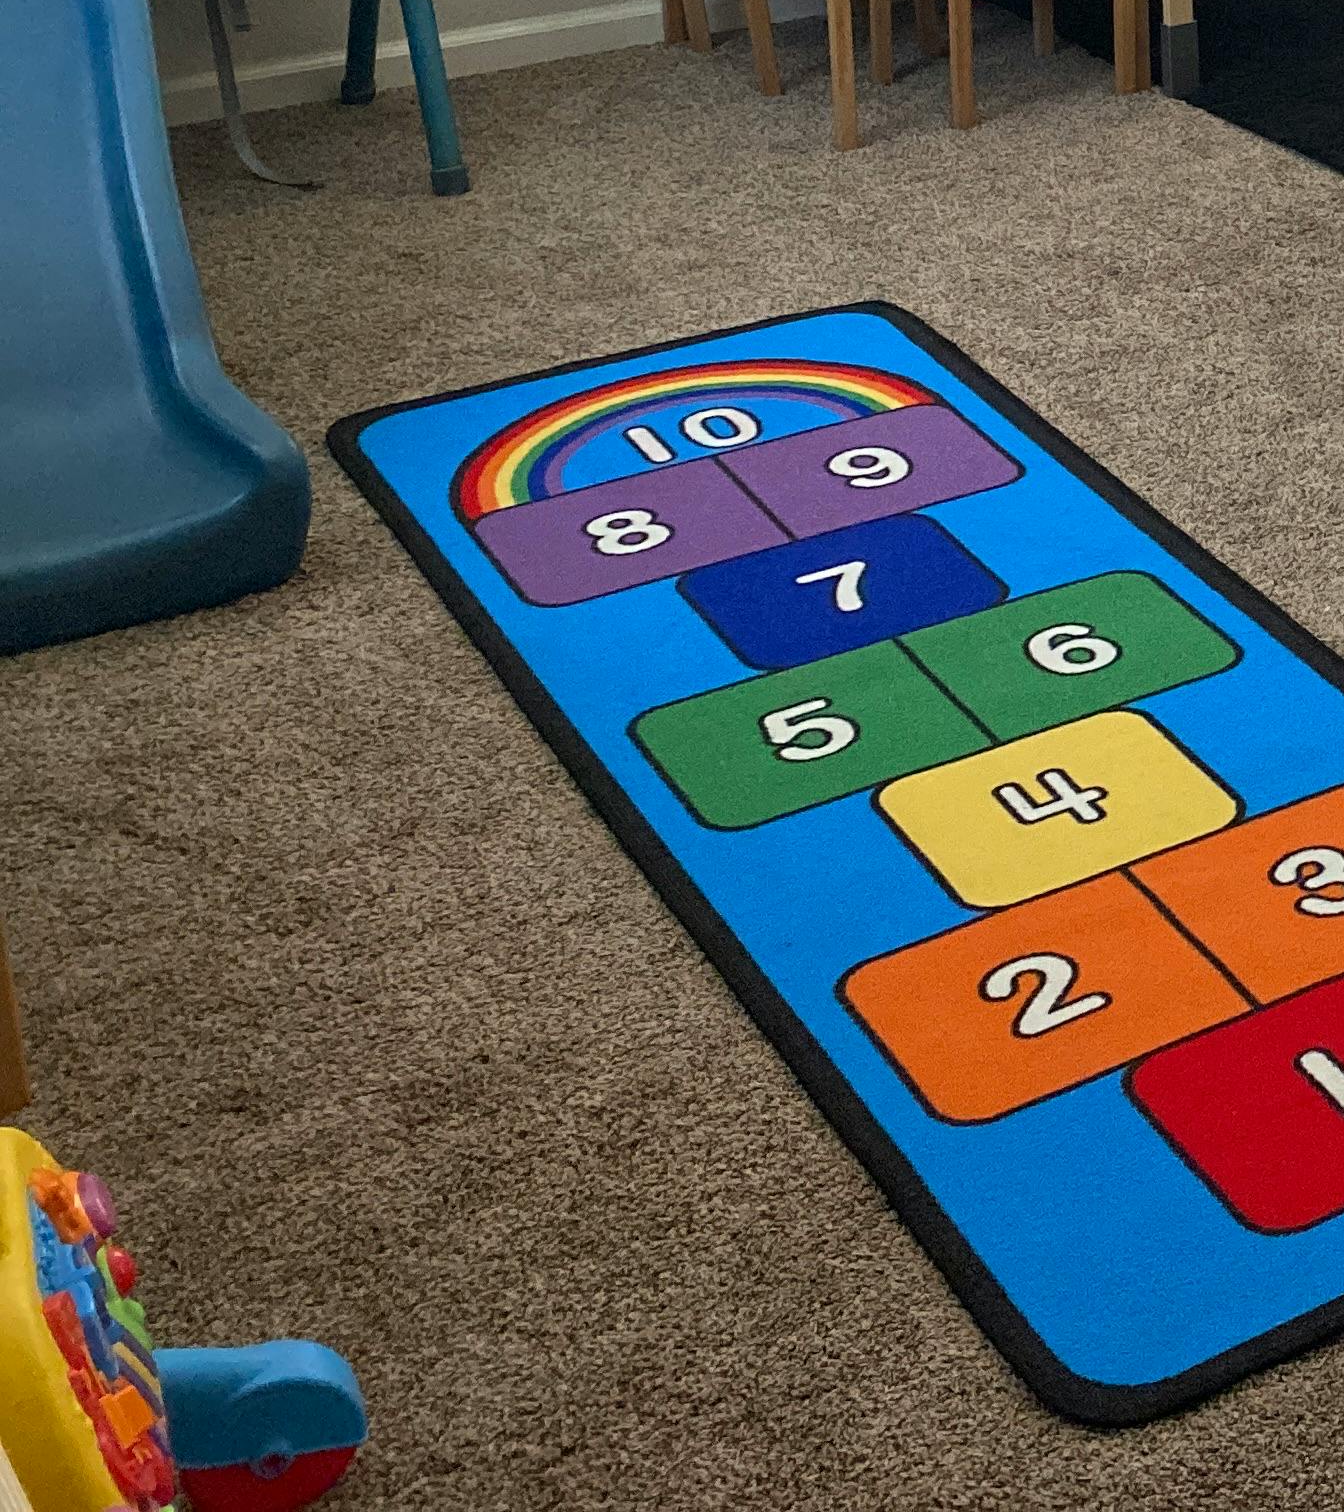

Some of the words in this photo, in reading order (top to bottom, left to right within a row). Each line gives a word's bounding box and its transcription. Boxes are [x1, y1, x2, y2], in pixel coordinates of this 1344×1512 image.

[625, 406, 759, 465] 10
[827, 445, 911, 490] 9
[584, 508, 672, 557] 8
[794, 559, 868, 614] 7
[1021, 622, 1121, 676] 6
[758, 697, 859, 762] 5
[994, 766, 1108, 829] 4
[980, 952, 1112, 1037] 2
